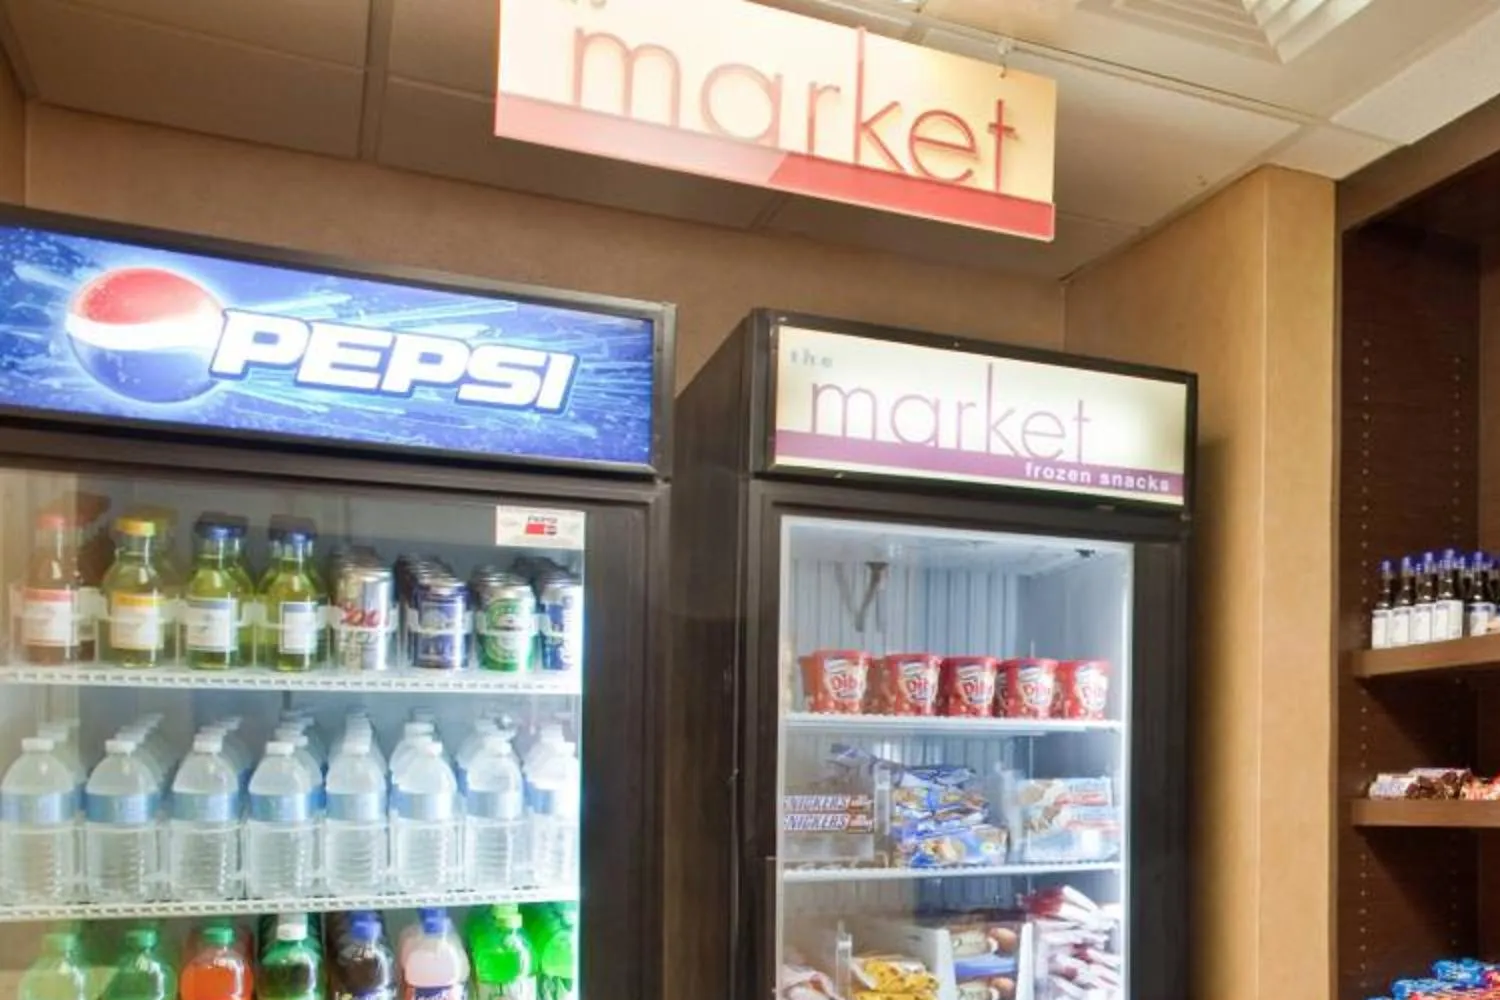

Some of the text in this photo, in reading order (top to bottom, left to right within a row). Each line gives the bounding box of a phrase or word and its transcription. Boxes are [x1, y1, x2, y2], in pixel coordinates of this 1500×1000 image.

[574, 26, 1018, 193] market
[211, 310, 577, 411] PEPSI
[789, 349, 834, 369] the
[812, 362, 1092, 464] market
[1025, 463, 1169, 493] frozen snacks
